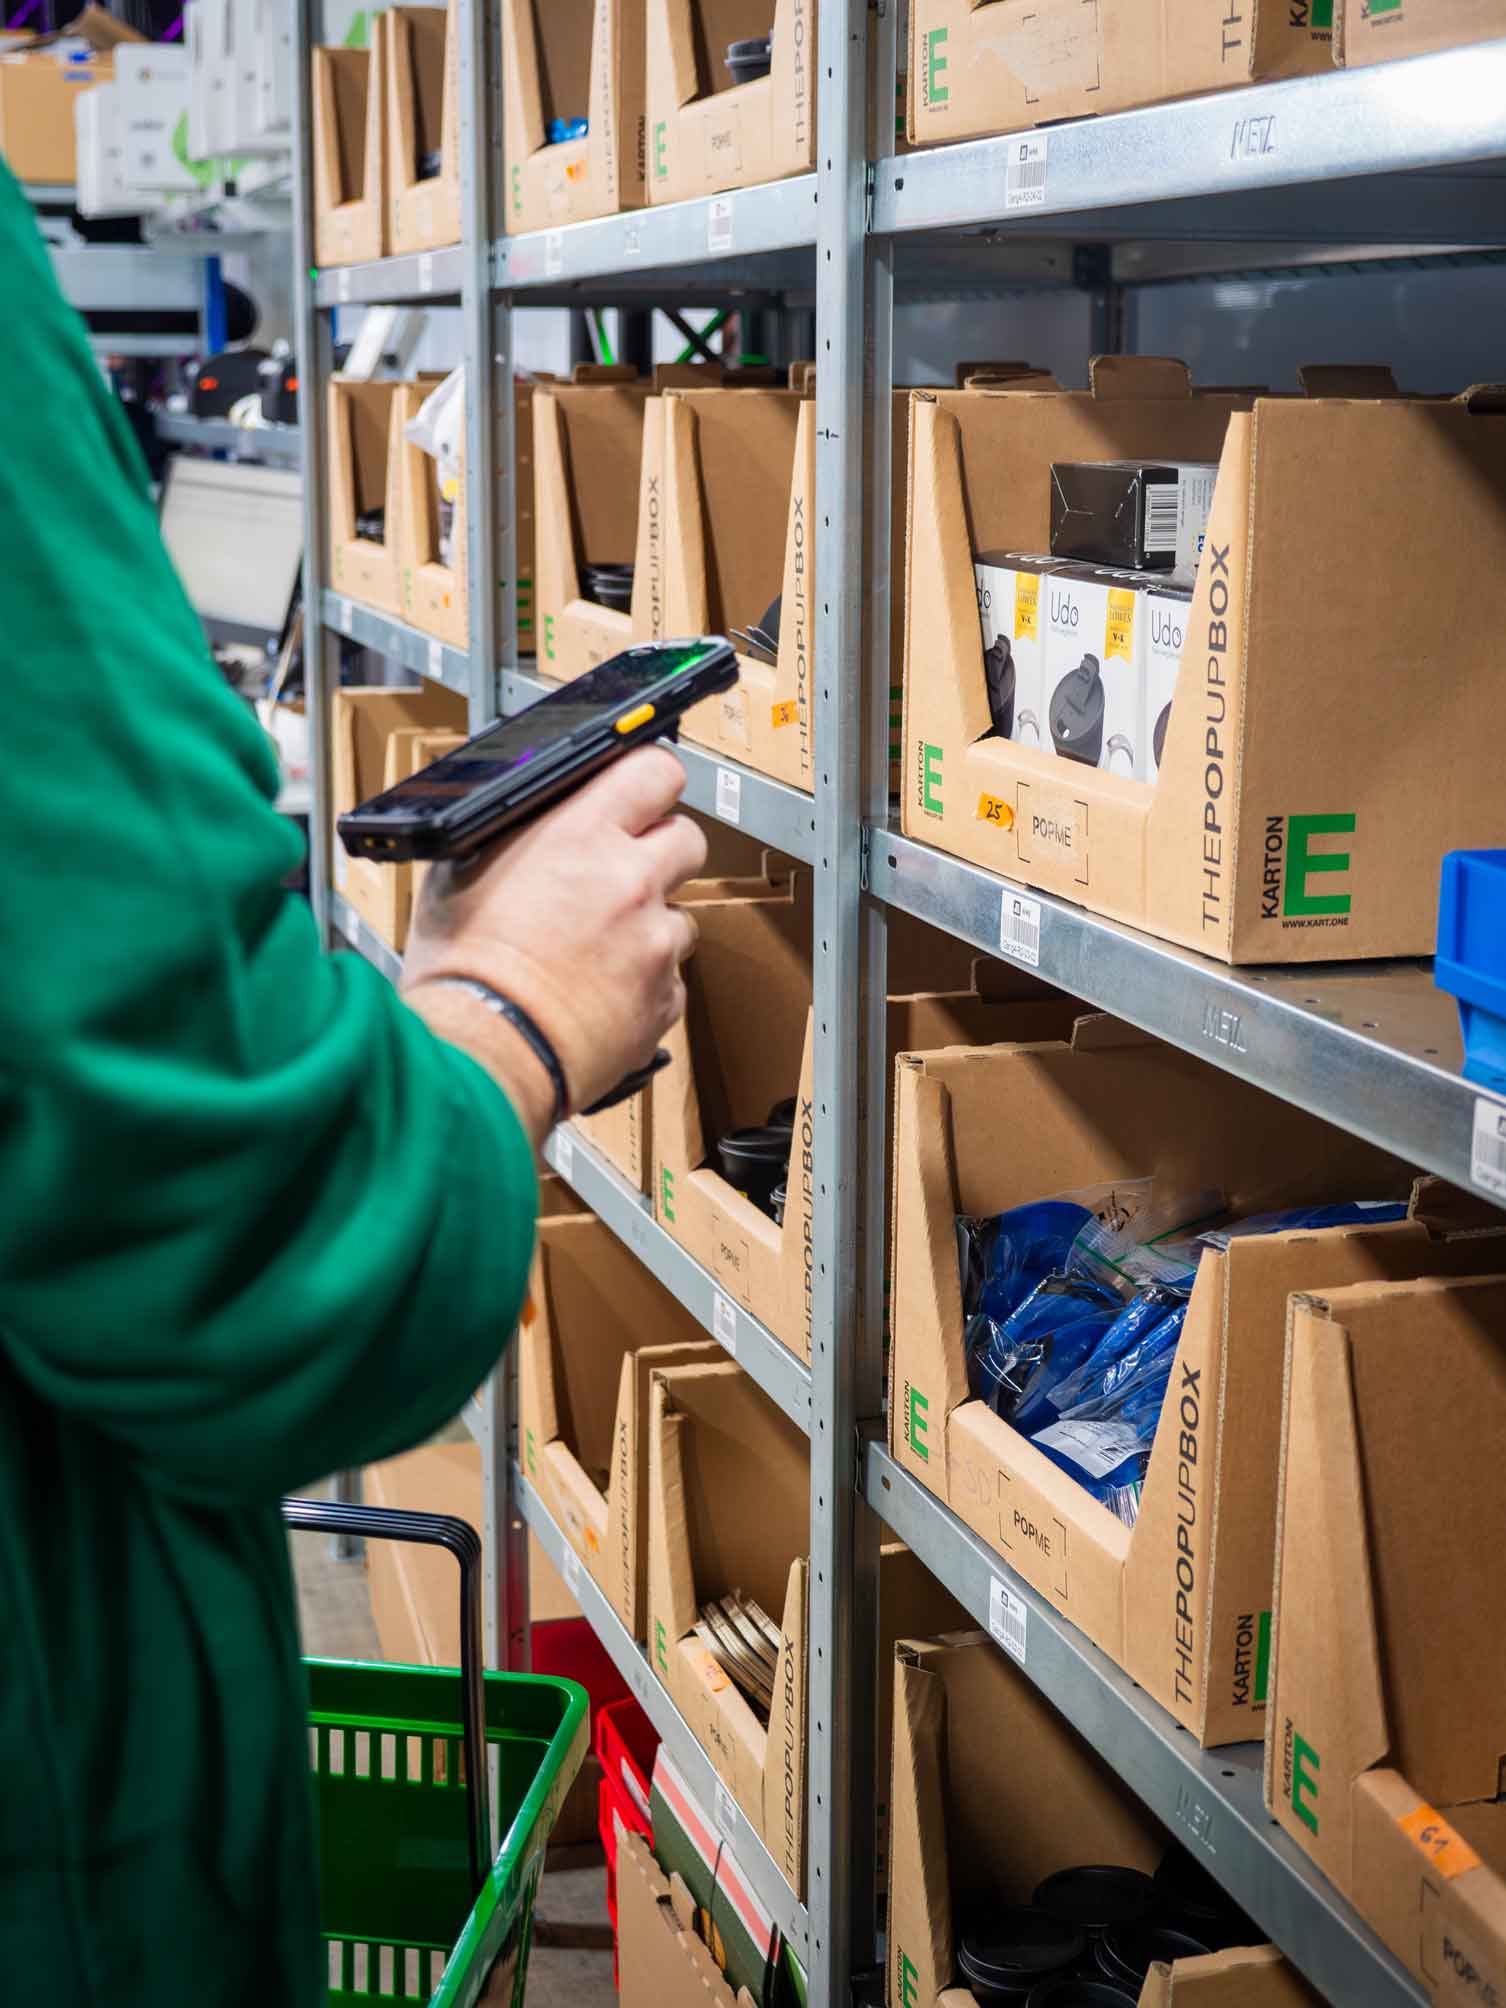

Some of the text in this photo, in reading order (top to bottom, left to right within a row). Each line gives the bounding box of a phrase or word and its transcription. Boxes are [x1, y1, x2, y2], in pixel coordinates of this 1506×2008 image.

[928, 27, 949, 103] E
[795, 496, 808, 775] THEPOPUPBOX
[1050, 592, 1079, 627] Udo
[1151, 609, 1182, 649] Udo
[1202, 543, 1230, 931] THEPOPUPBOX
[924, 744, 944, 814] E
[986, 800, 1003, 820] 25
[1033, 816, 1072, 848] POPME
[1261, 813, 1356, 919] KARTON E
[1281, 916, 1349, 929] WWW.KART.ONE
[801, 1096, 813, 1354] THEPOPUPBOX
[903, 1381, 911, 1442] KARTON
[1013, 1509, 1051, 1558] POPME
[1173, 1359, 1201, 1706] THEPOPUPBOX
[1232, 1614, 1254, 1706] KARTON
[784, 1632, 796, 1877] THEPOPUPBOX
[1283, 1717, 1293, 1799] KARTON
